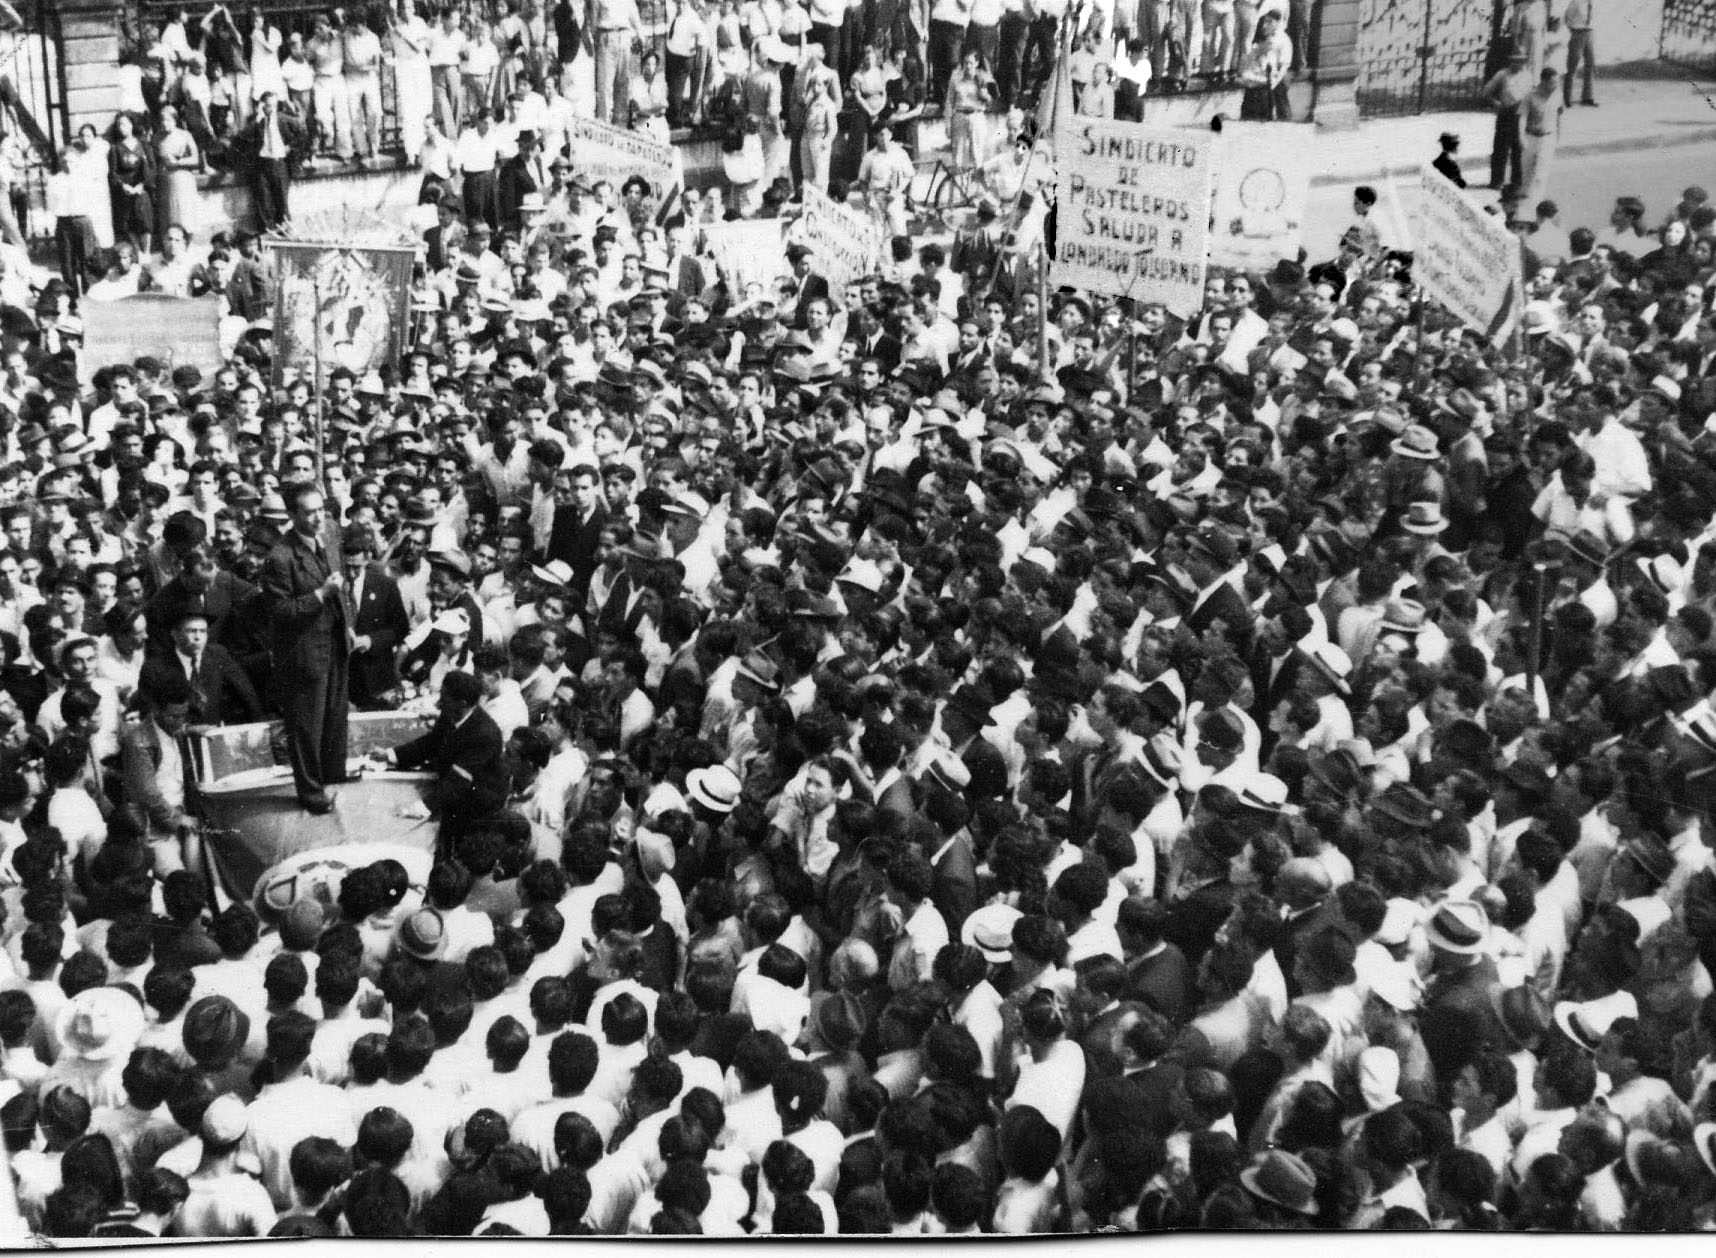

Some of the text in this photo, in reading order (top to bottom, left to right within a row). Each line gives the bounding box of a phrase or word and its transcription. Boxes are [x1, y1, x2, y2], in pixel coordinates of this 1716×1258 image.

[1082, 126, 1196, 168] SINDICATO
[1070, 173, 1189, 221] PASTELEROS
[1116, 166, 1139, 186] DE
[1082, 208, 1183, 250] SALUDA A
